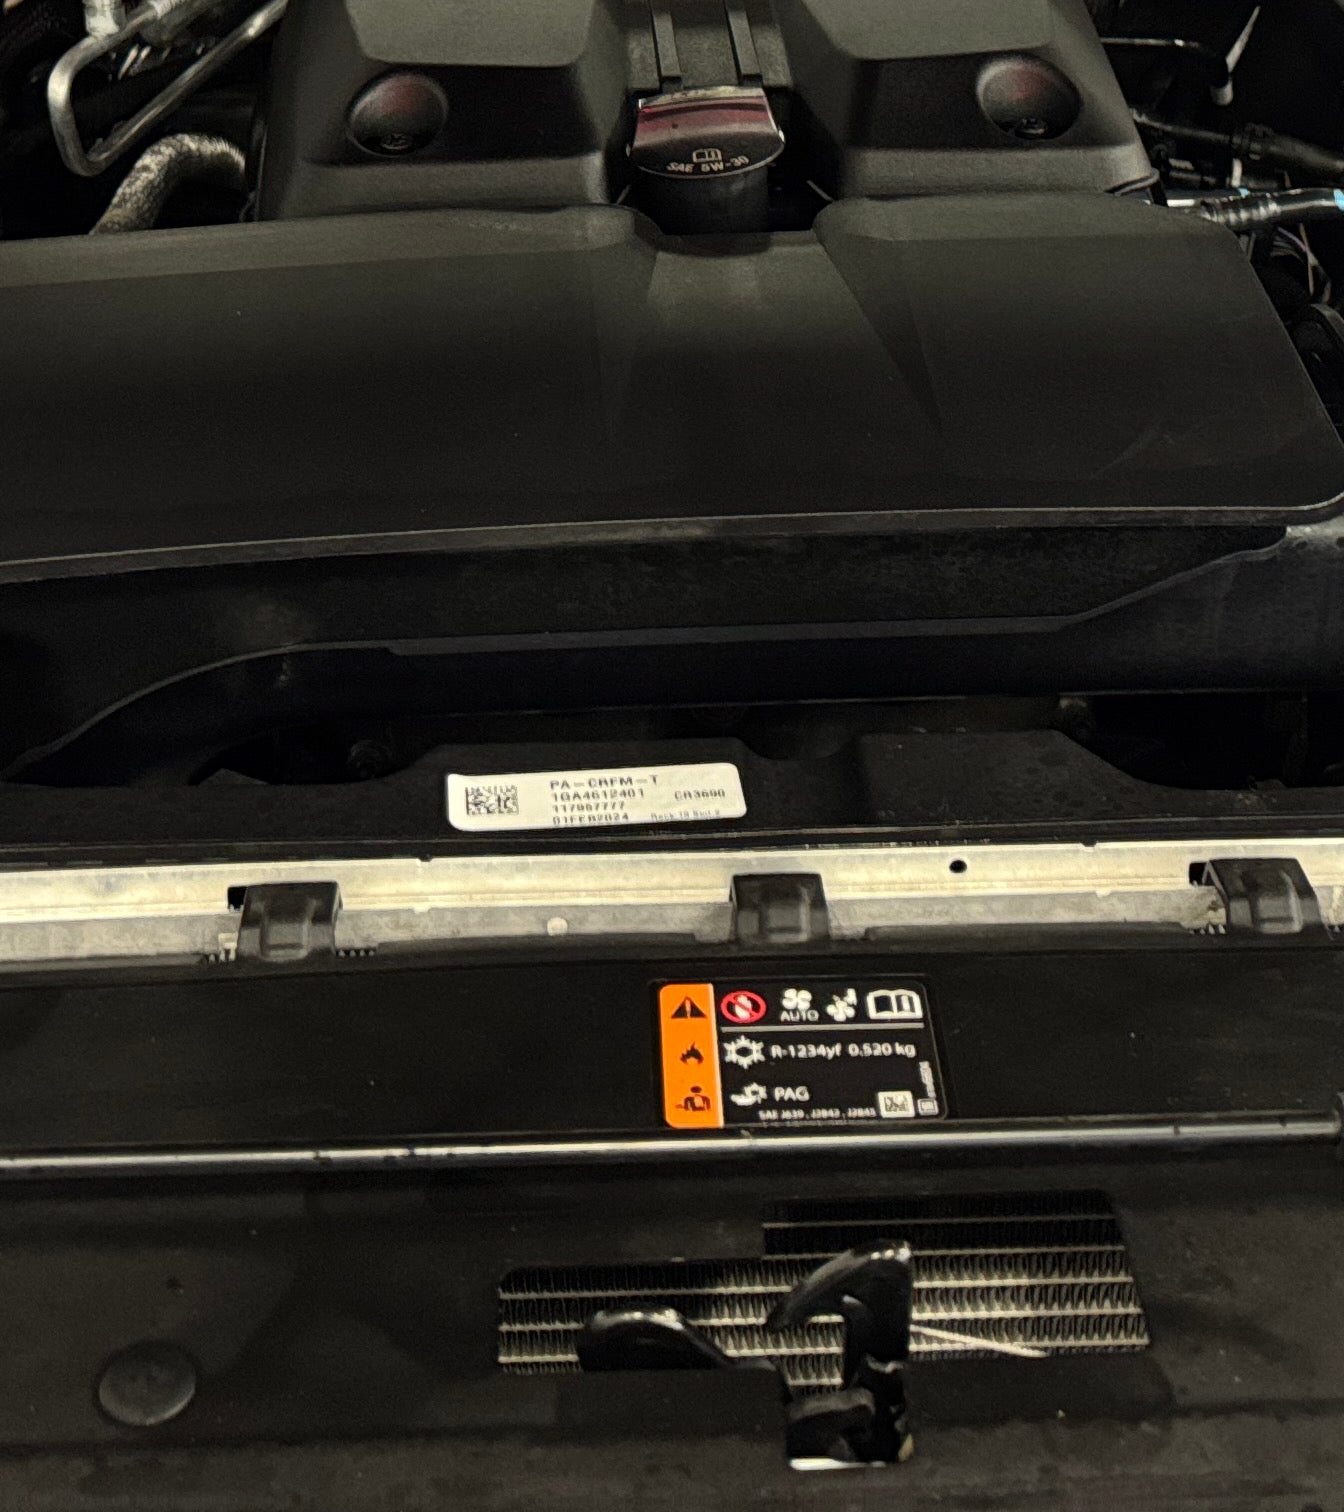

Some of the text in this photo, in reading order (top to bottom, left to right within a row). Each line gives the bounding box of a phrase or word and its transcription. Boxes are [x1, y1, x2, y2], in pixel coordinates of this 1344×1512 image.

[667, 155, 750, 173] SAE 5W-30
[780, 1010, 820, 1022] AUTO
[770, 1042, 917, 1060] R-1234yf 0.520 kg
[774, 1086, 810, 1101] PAG
